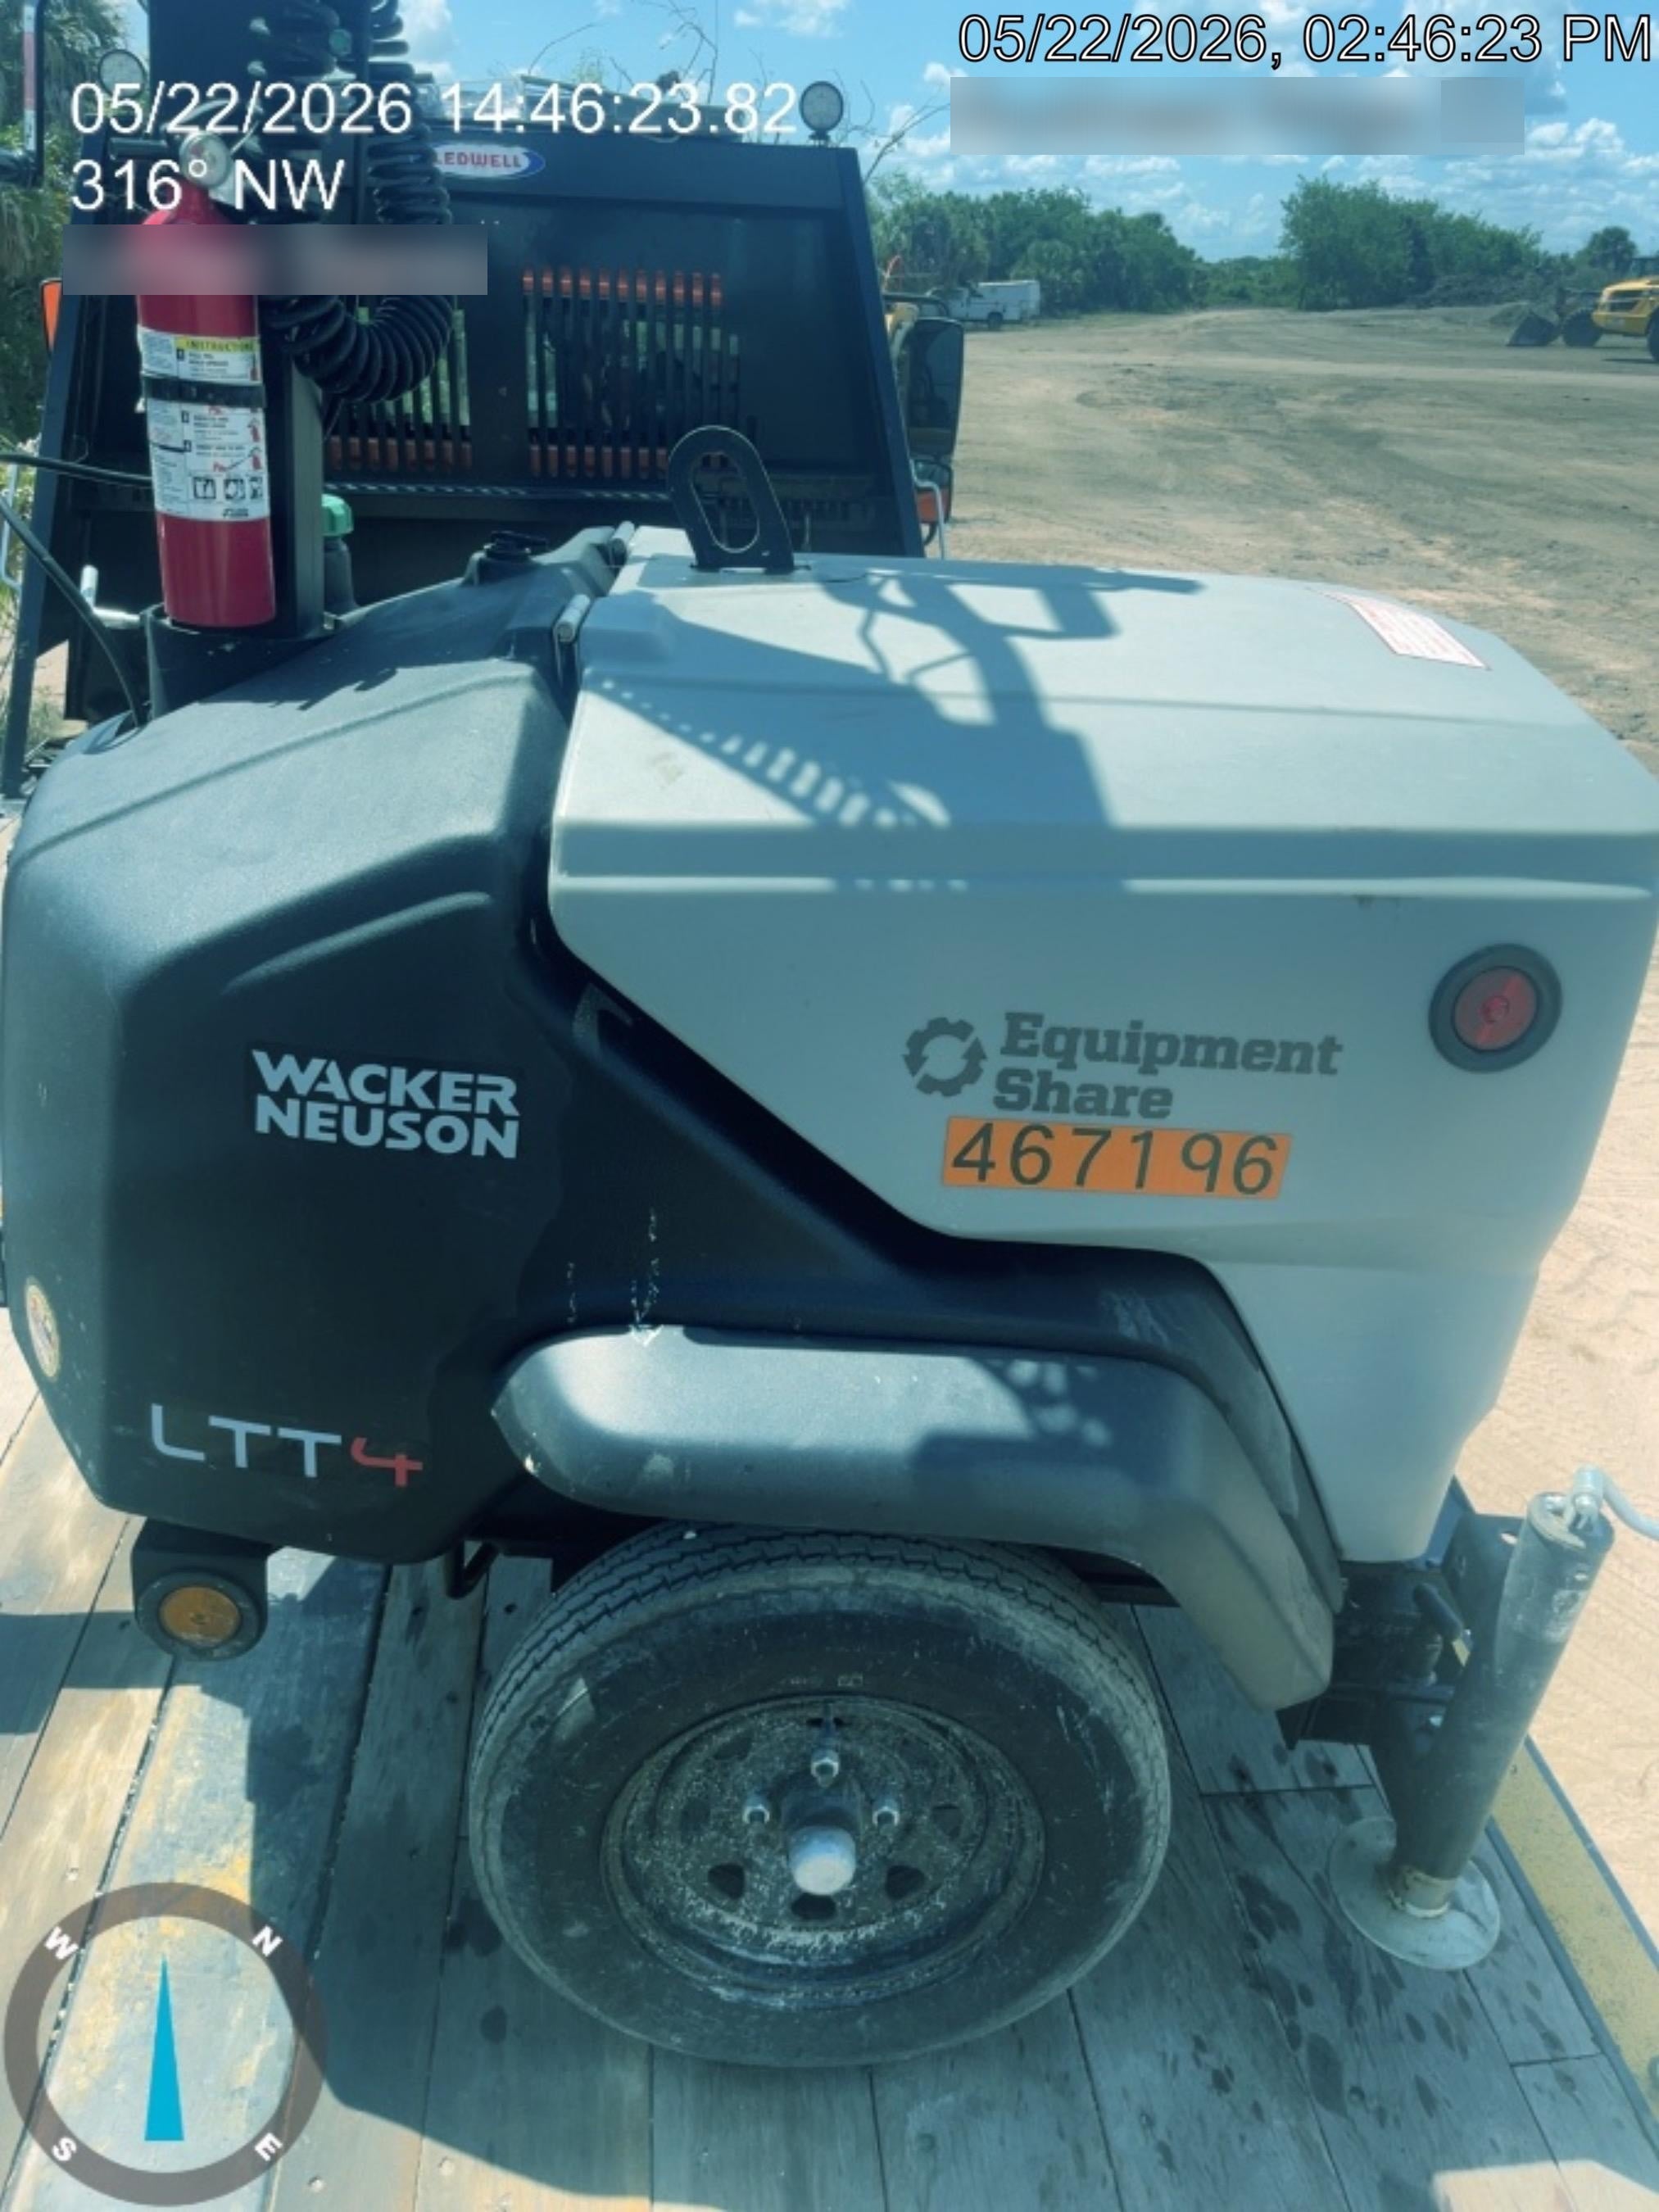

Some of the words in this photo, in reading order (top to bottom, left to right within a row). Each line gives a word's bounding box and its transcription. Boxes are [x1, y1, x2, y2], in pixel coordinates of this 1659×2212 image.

[436, 152, 522, 168] EDWELL
[999, 1012, 1344, 1075] Equipment
[252, 1049, 520, 1116] WACKER
[993, 1067, 1173, 1119] Share
[255, 1093, 519, 1159] NEUSON
[951, 1122, 1278, 1195] 467196
[151, 1403, 424, 1487] LTT4
